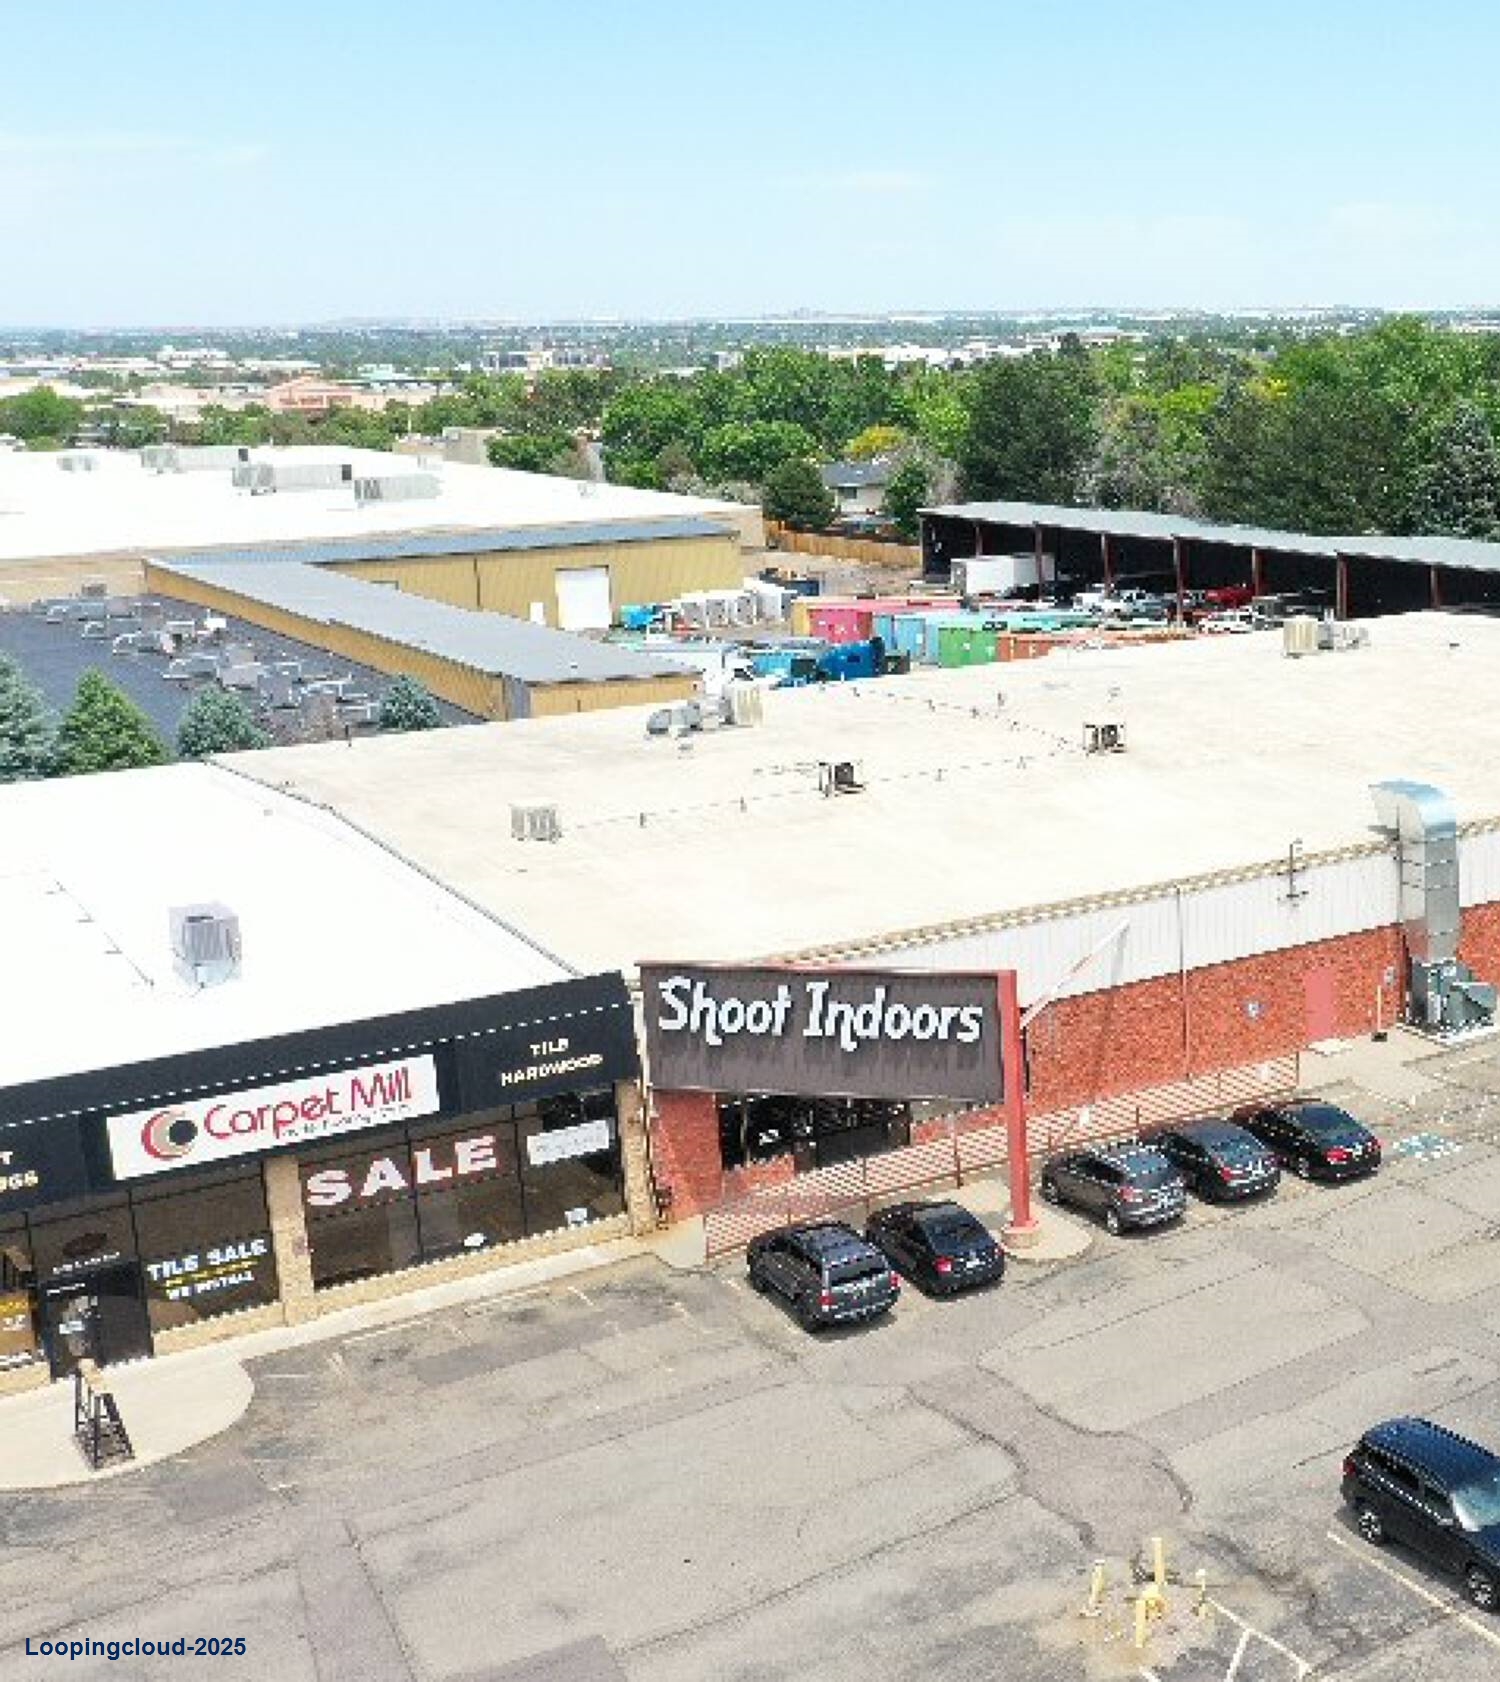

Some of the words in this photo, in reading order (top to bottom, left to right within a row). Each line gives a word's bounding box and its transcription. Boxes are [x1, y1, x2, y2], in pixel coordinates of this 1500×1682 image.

[658, 976, 792, 1045] Shoot
[803, 981, 983, 1051] Indoors
[204, 1087, 343, 1139] Carpet
[351, 1066, 412, 1112] Mill
[501, 1053, 604, 1087] HARDWOOD
[307, 1135, 497, 1206] SALE
[146, 1253, 199, 1281] TILE
[206, 1238, 268, 1266] SALE
